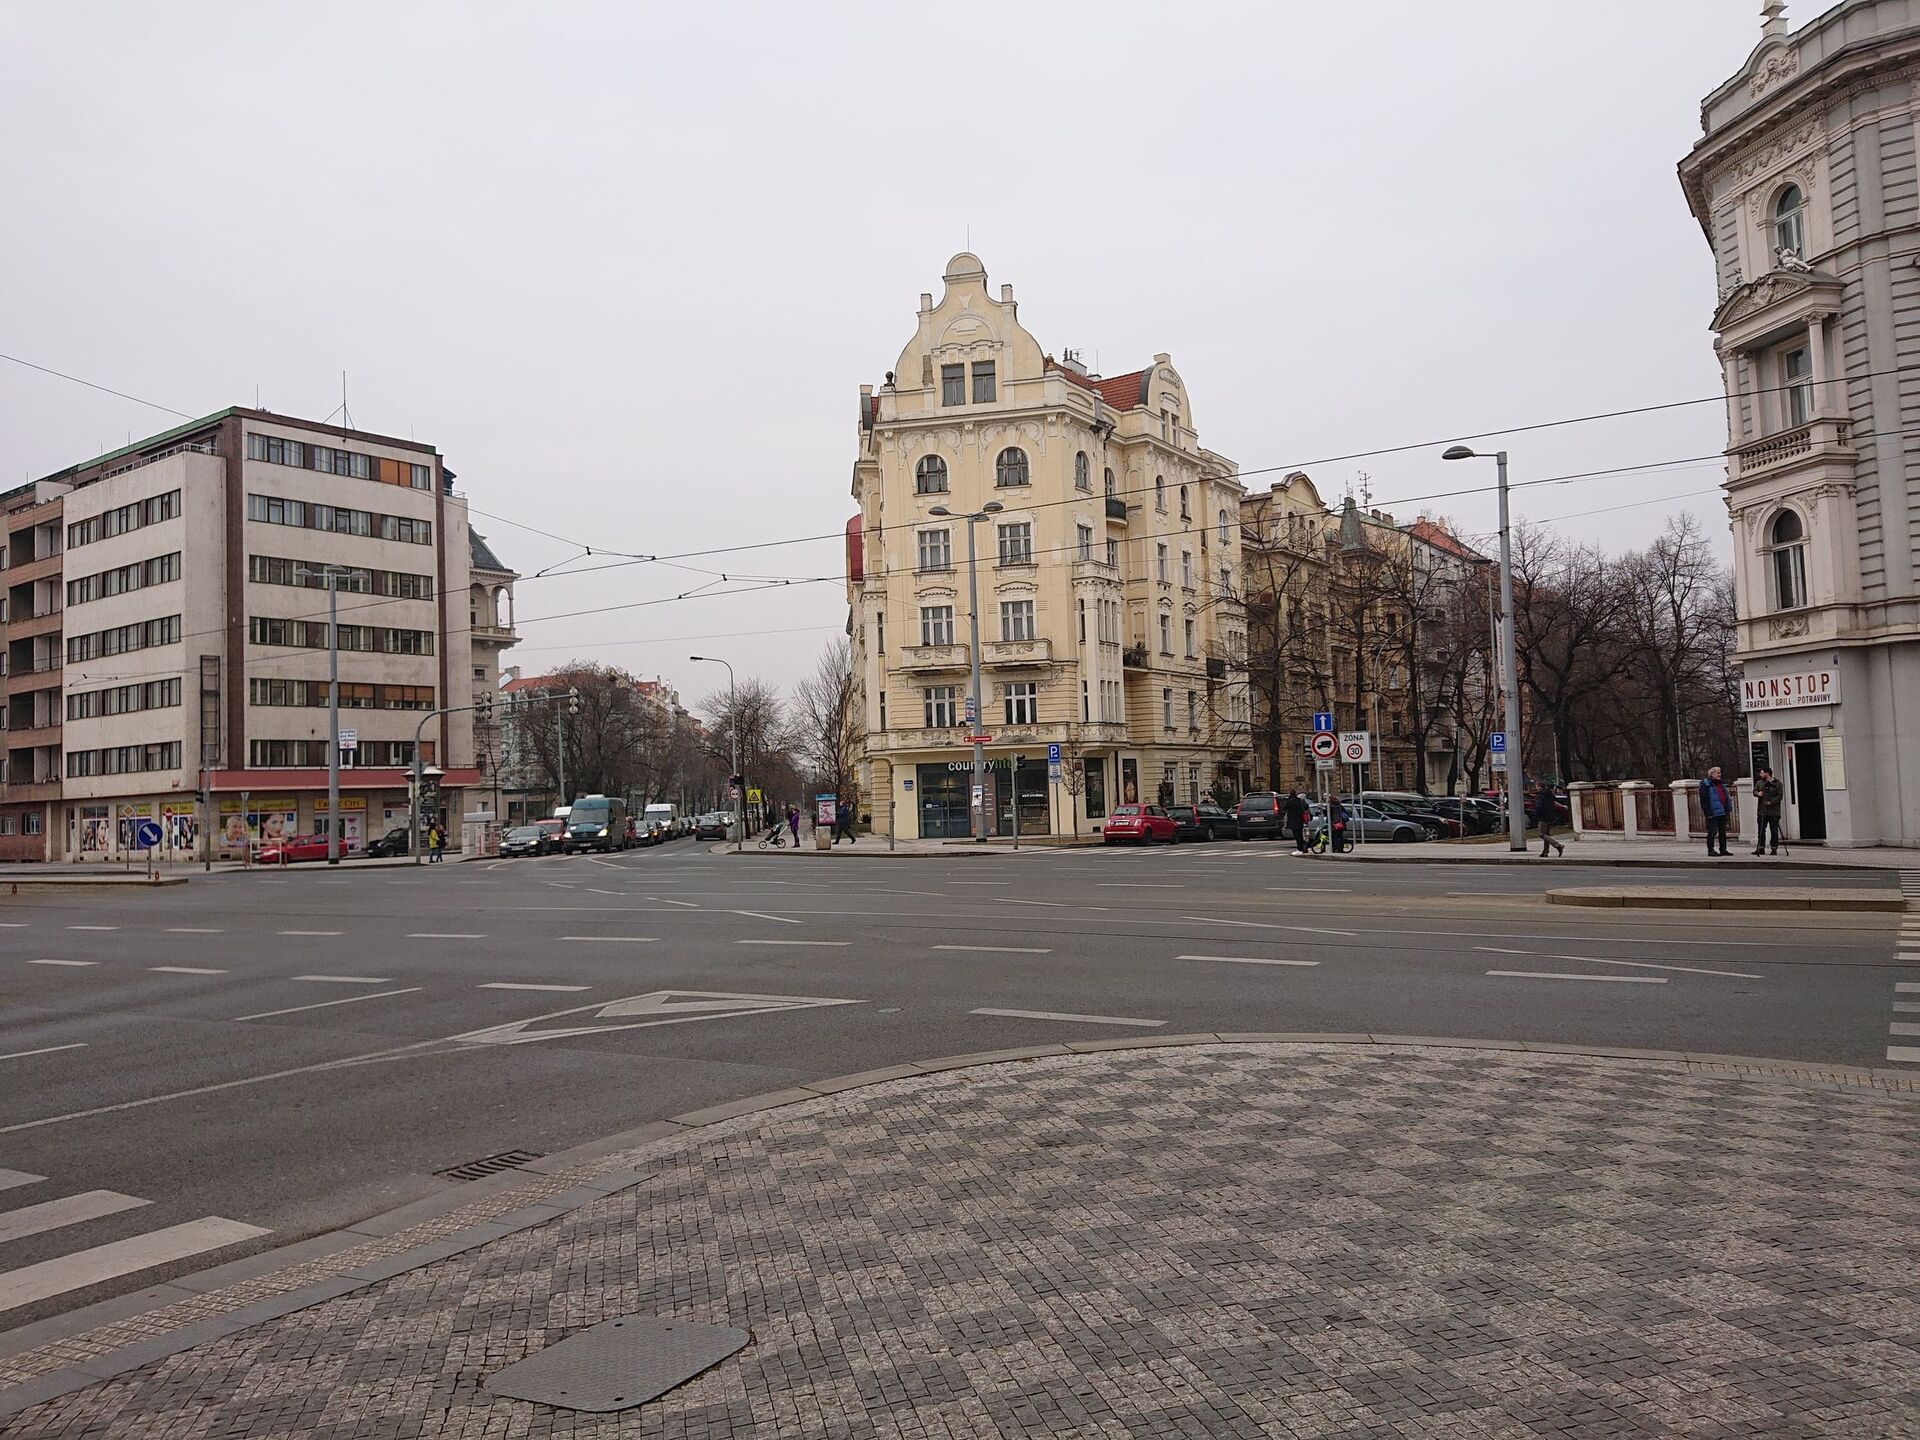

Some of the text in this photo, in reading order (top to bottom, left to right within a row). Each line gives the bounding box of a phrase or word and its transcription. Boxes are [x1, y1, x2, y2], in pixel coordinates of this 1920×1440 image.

[1745, 673, 1830, 699] NONSTOP
[1775, 697, 1792, 706] GRILL
[1797, 693, 1831, 704] POTRAVINY
[1493, 735, 1503, 747] P
[1050, 746, 1058, 758] P
[1350, 747, 1360, 756] 30
